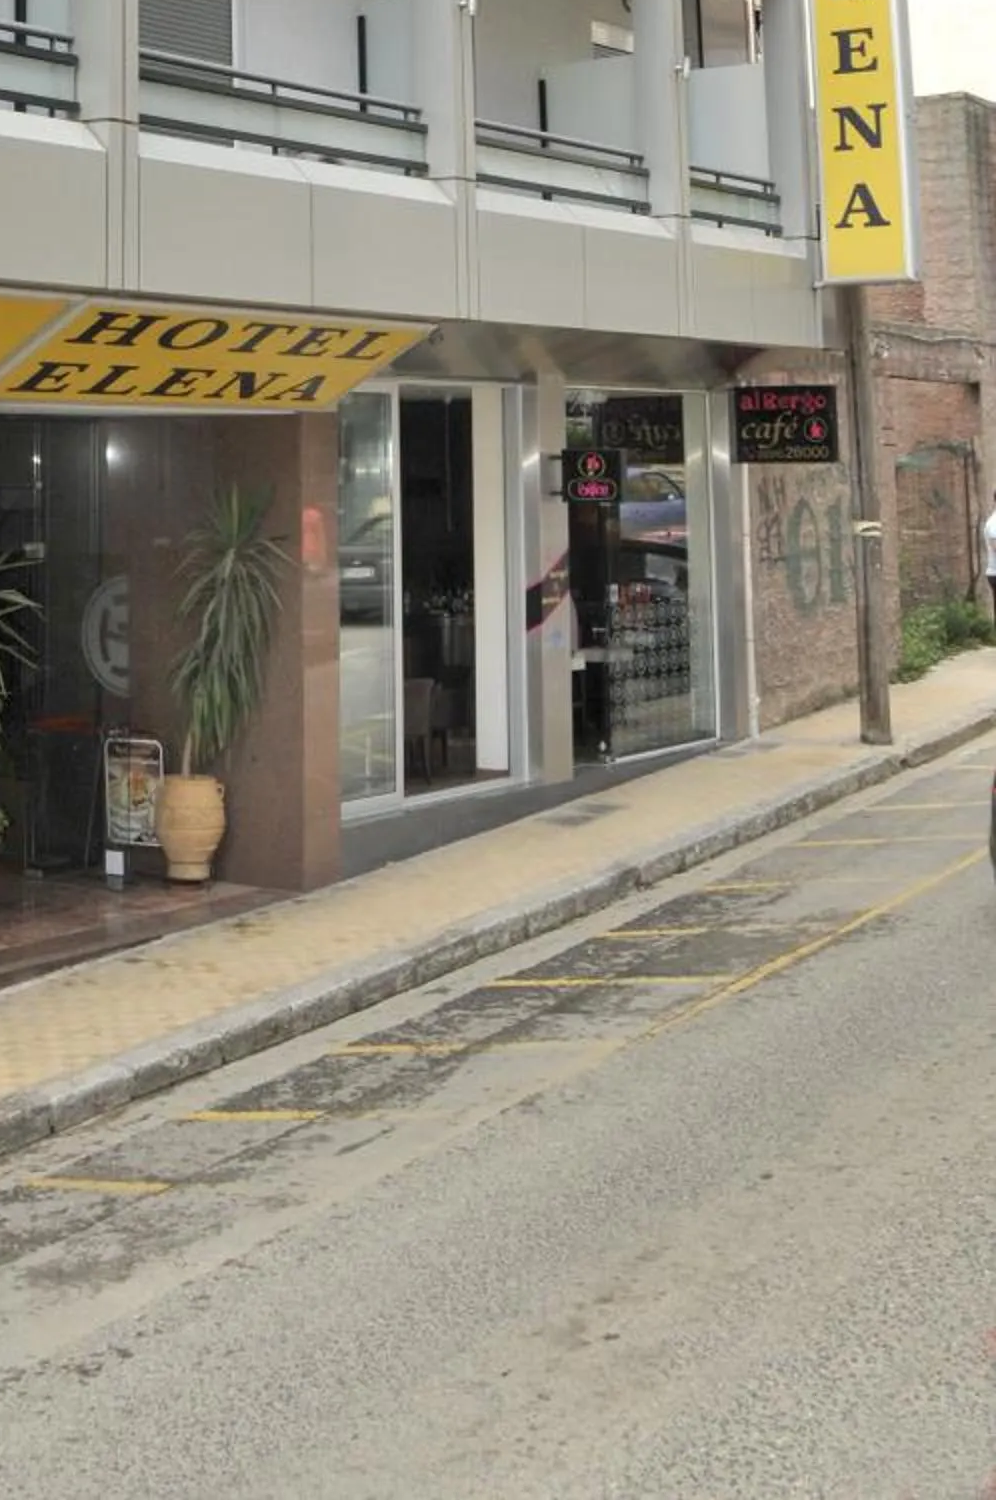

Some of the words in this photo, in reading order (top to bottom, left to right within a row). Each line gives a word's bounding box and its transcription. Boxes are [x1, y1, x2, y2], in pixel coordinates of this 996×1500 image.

[65, 310, 390, 362] HOTEL
[8, 360, 328, 402] ELENA
[741, 411, 798, 449] café
